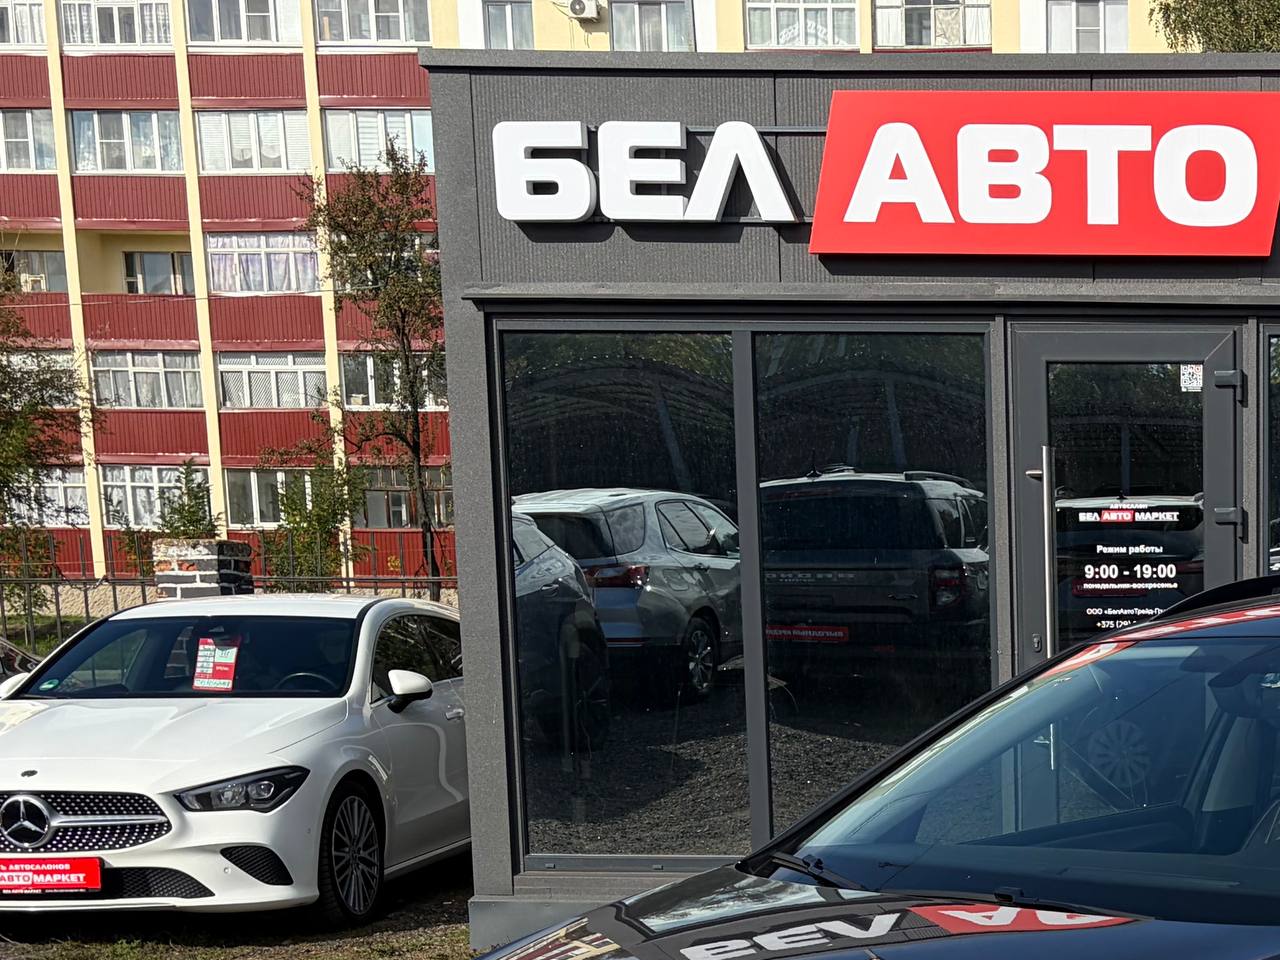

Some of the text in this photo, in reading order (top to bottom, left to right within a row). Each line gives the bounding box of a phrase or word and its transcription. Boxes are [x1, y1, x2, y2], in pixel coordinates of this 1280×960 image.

[492, 120, 801, 223] БЕЛ
[842, 121, 1258, 227] АВТО
[1079, 511, 1180, 521] БЕЛ АВТО МАРКЕТ
[1096, 544, 1163, 555] Режим работы
[1084, 564, 1119, 579] 9:00
[1133, 564, 1177, 579] 19:00
[1096, 620, 1116, 629] +375
[33, 873, 86, 883] МАРКЕТ
